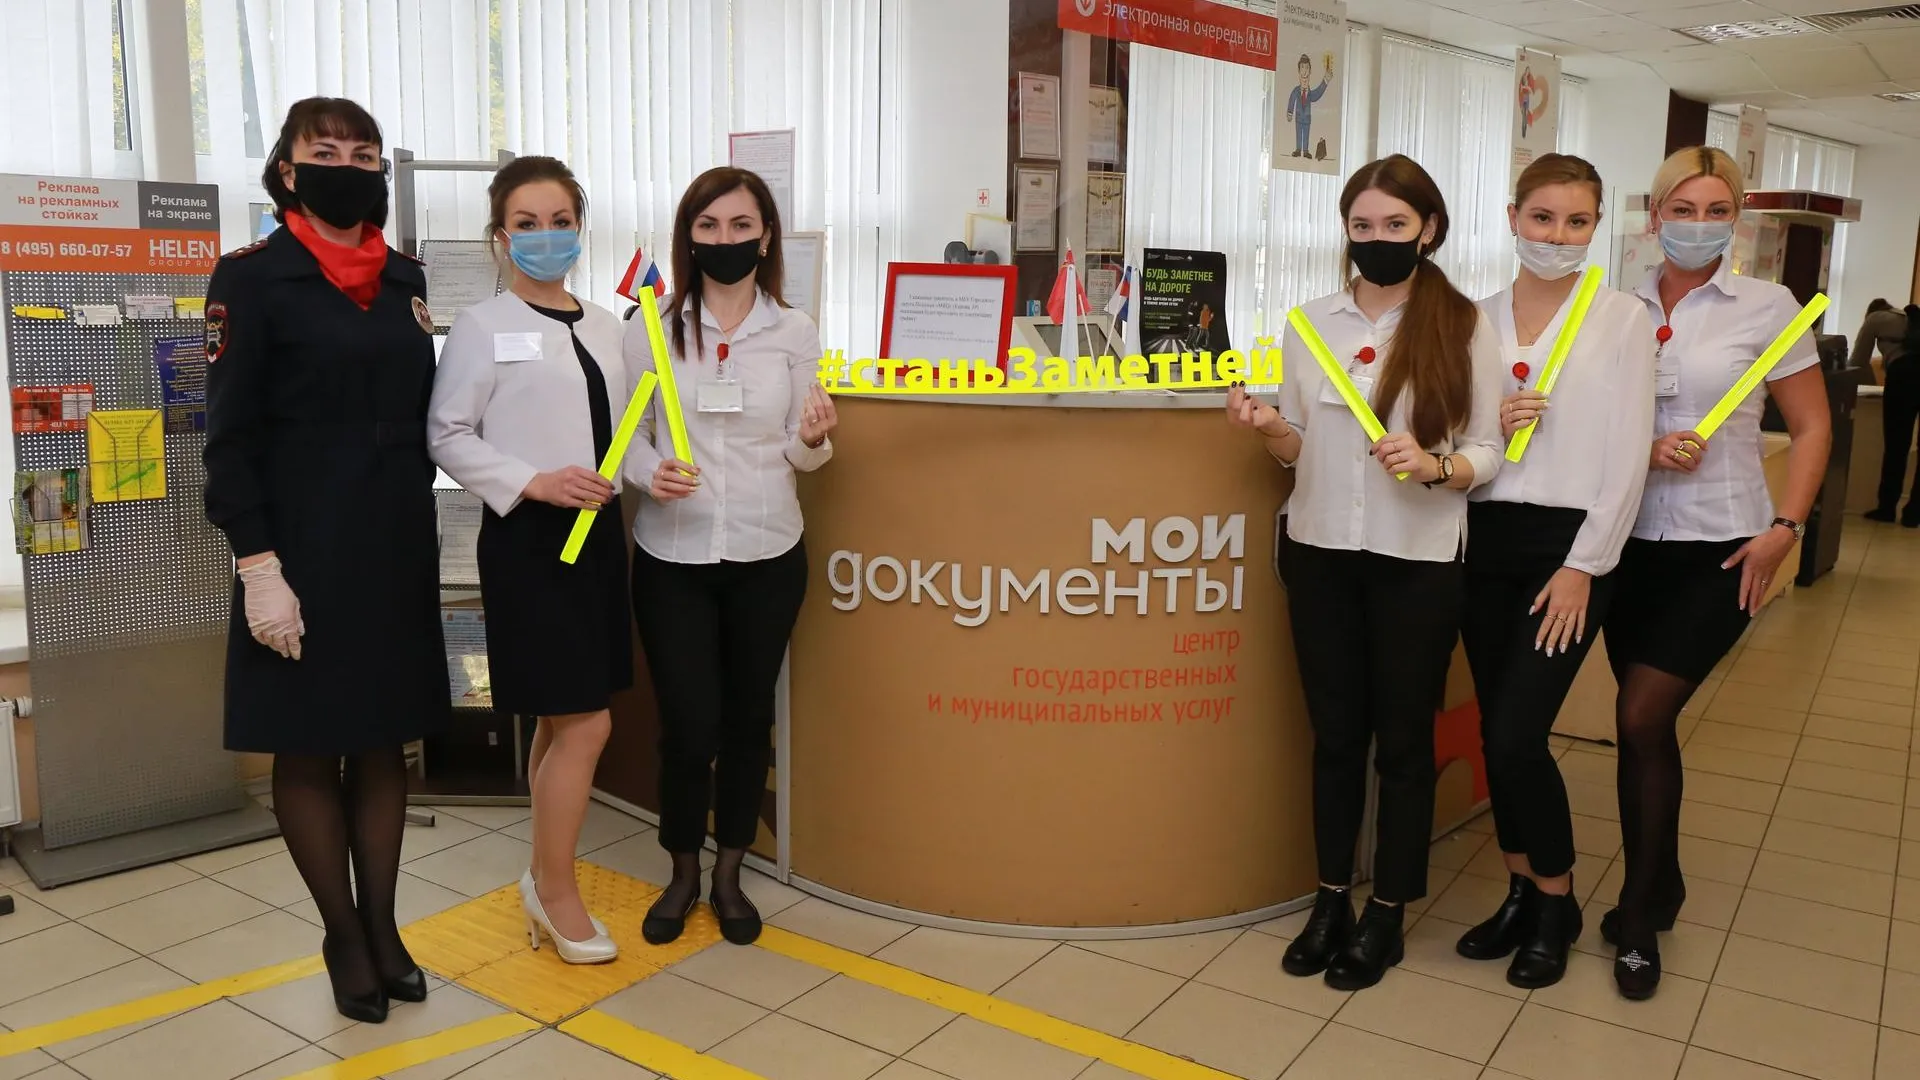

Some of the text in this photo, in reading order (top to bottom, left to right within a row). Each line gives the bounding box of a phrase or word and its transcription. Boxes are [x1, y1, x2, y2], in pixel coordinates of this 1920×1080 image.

[1102, 0, 1244, 45] Электронная очередь
[37, 181, 100, 195] Реклама
[18, 195, 119, 209] на рекламных
[151, 194, 208, 208] Реклама
[41, 208, 99, 221] стойках
[147, 208, 212, 222] на экране
[1, 241, 132, 259] 8 (495) 660-07-57
[149, 239, 215, 259] HELEN
[148, 259, 191, 267] GROUP
[1146, 268, 1214, 282] БУДЬ ЗАМЕТНЕЕ
[1145, 281, 1192, 294] НА ДОРОГЕ
[816, 337, 1284, 394] #станьЗаметней
[1091, 513, 1246, 563] мои
[827, 549, 1244, 627] документы
[1173, 630, 1241, 655] центр
[1012, 663, 1237, 695] государственных
[928, 694, 1235, 725] и муниципальных услуг
